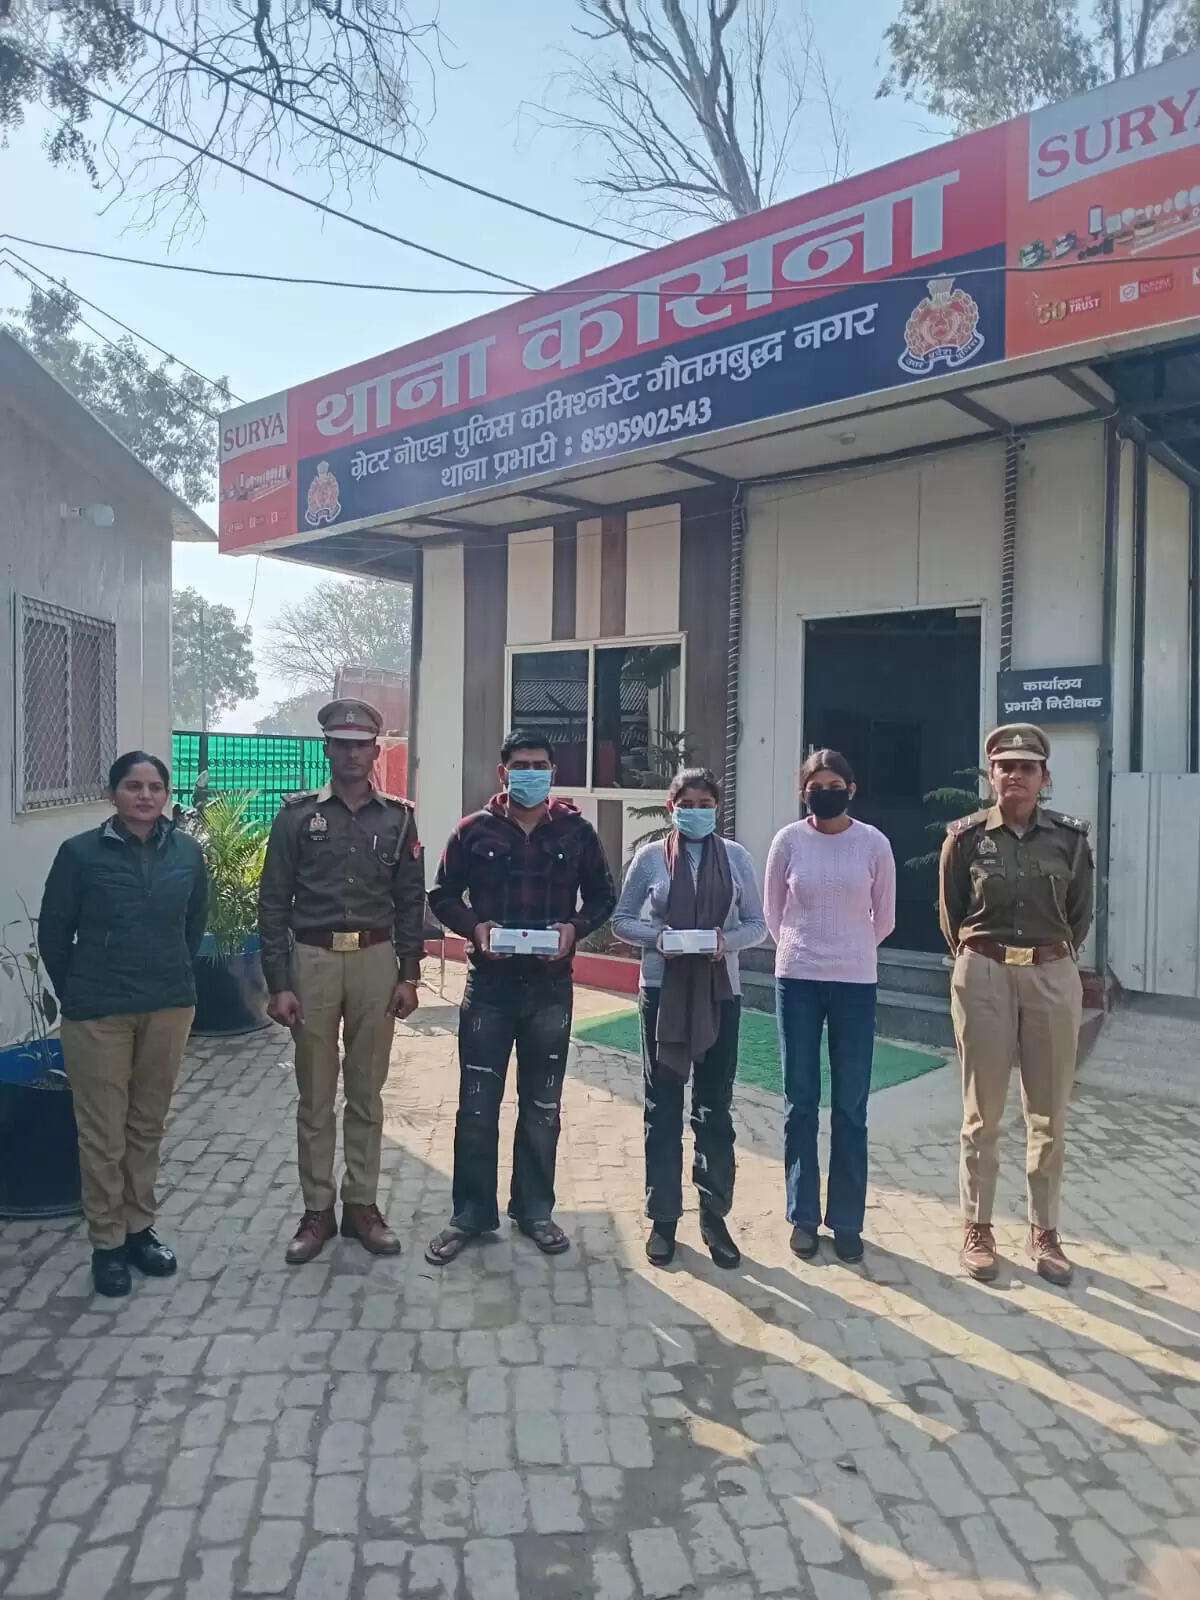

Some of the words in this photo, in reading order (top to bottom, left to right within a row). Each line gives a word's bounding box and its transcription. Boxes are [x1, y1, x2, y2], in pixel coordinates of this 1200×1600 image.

[1037, 87, 1200, 178] SURY
[315, 335, 497, 437] थाना
[518, 168, 960, 371] कासना
[1069, 298, 1100, 313] TRUST
[351, 449, 391, 480] ग्रेटर
[394, 432, 449, 464] नोएडा
[453, 411, 516, 459] पुलिस
[520, 373, 642, 429] कमिश्नरेट
[645, 330, 786, 392] गौतमबुद्ध
[793, 302, 879, 349] नगर
[223, 412, 285, 453] SURYA
[441, 457, 489, 488] थाना
[493, 431, 558, 480] प्रभारी
[580, 397, 712, 453] 8595902543
[1004, 697, 1043, 714] प्रभारी
[1046, 695, 1103, 710] निरीक्षक
[1022, 676, 1083, 691] कार्यालय
